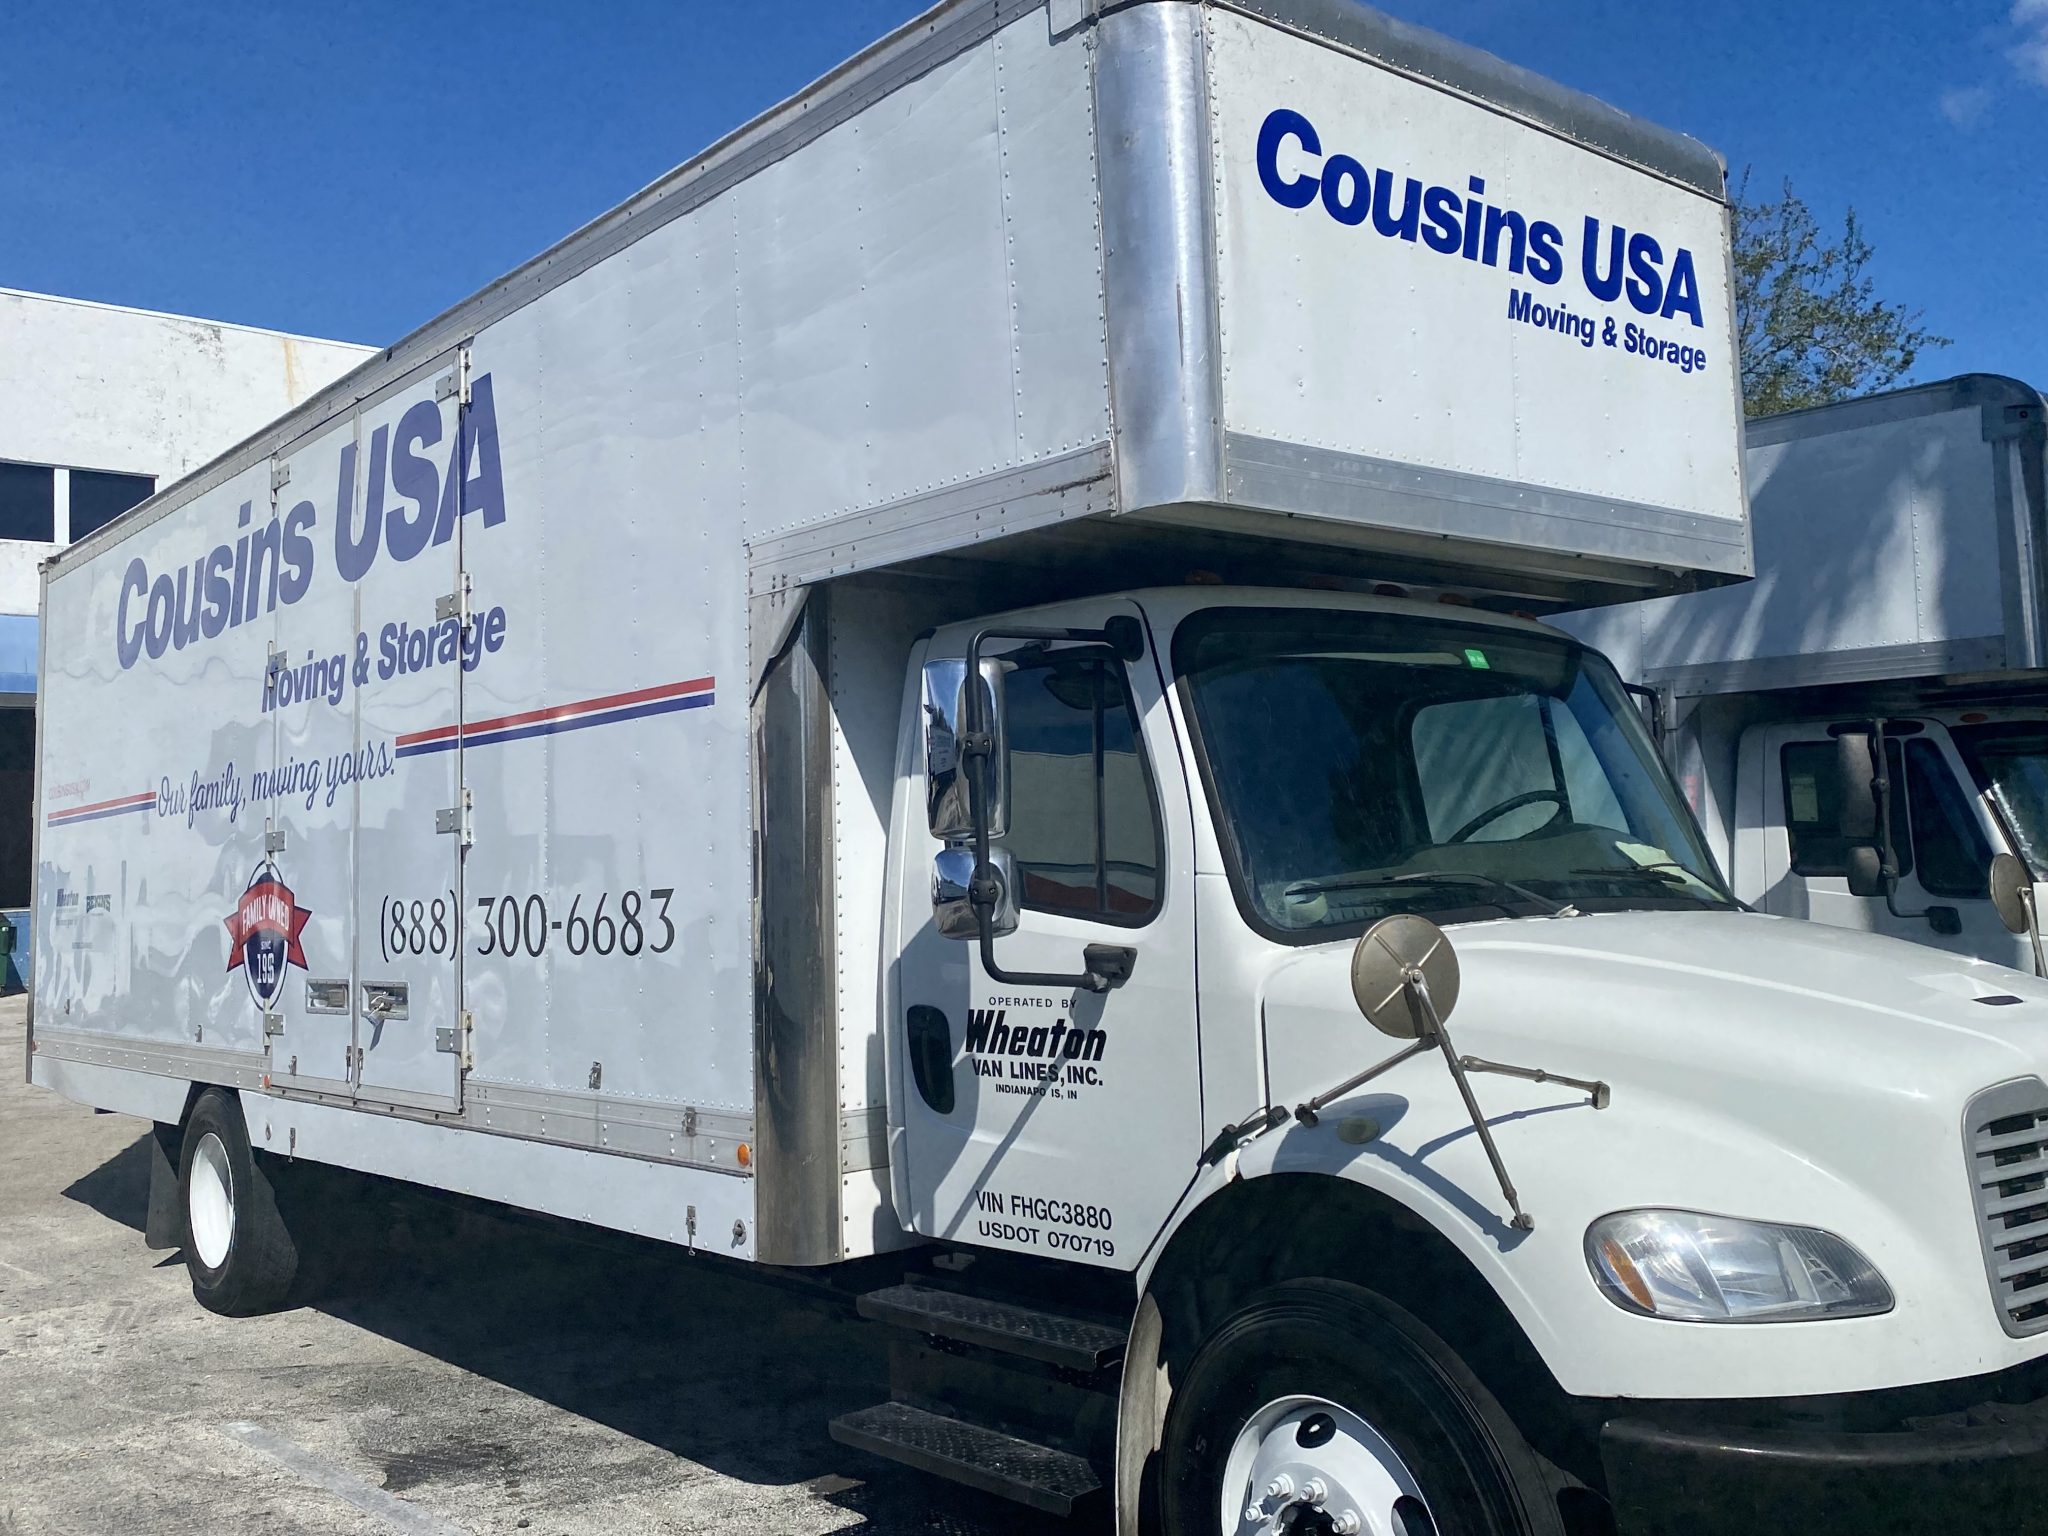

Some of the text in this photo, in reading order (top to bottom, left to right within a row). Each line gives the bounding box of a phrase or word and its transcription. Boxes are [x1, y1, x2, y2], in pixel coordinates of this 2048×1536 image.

[1257, 108, 1704, 328] Cousins USA
[1508, 288, 1707, 374] Moving & Storage
[117, 373, 506, 670] Cousins USA
[352, 631, 370, 688] &
[378, 606, 506, 681] Storage
[158, 738, 395, 830] Our family, moving yours.
[242, 894, 267, 936] FAMILY
[381, 888, 676, 964] (888) 300-6683
[988, 996, 1077, 1009] OPERATED BY
[965, 1009, 1107, 1062] Wheaton
[972, 1058, 1003, 1079] VAN
[995, 1083, 1078, 1100] INDIANAPOIS, IN
[976, 1190, 1112, 1231] VIN FHGC3880
[978, 1220, 1115, 1257] USDOT 070719
